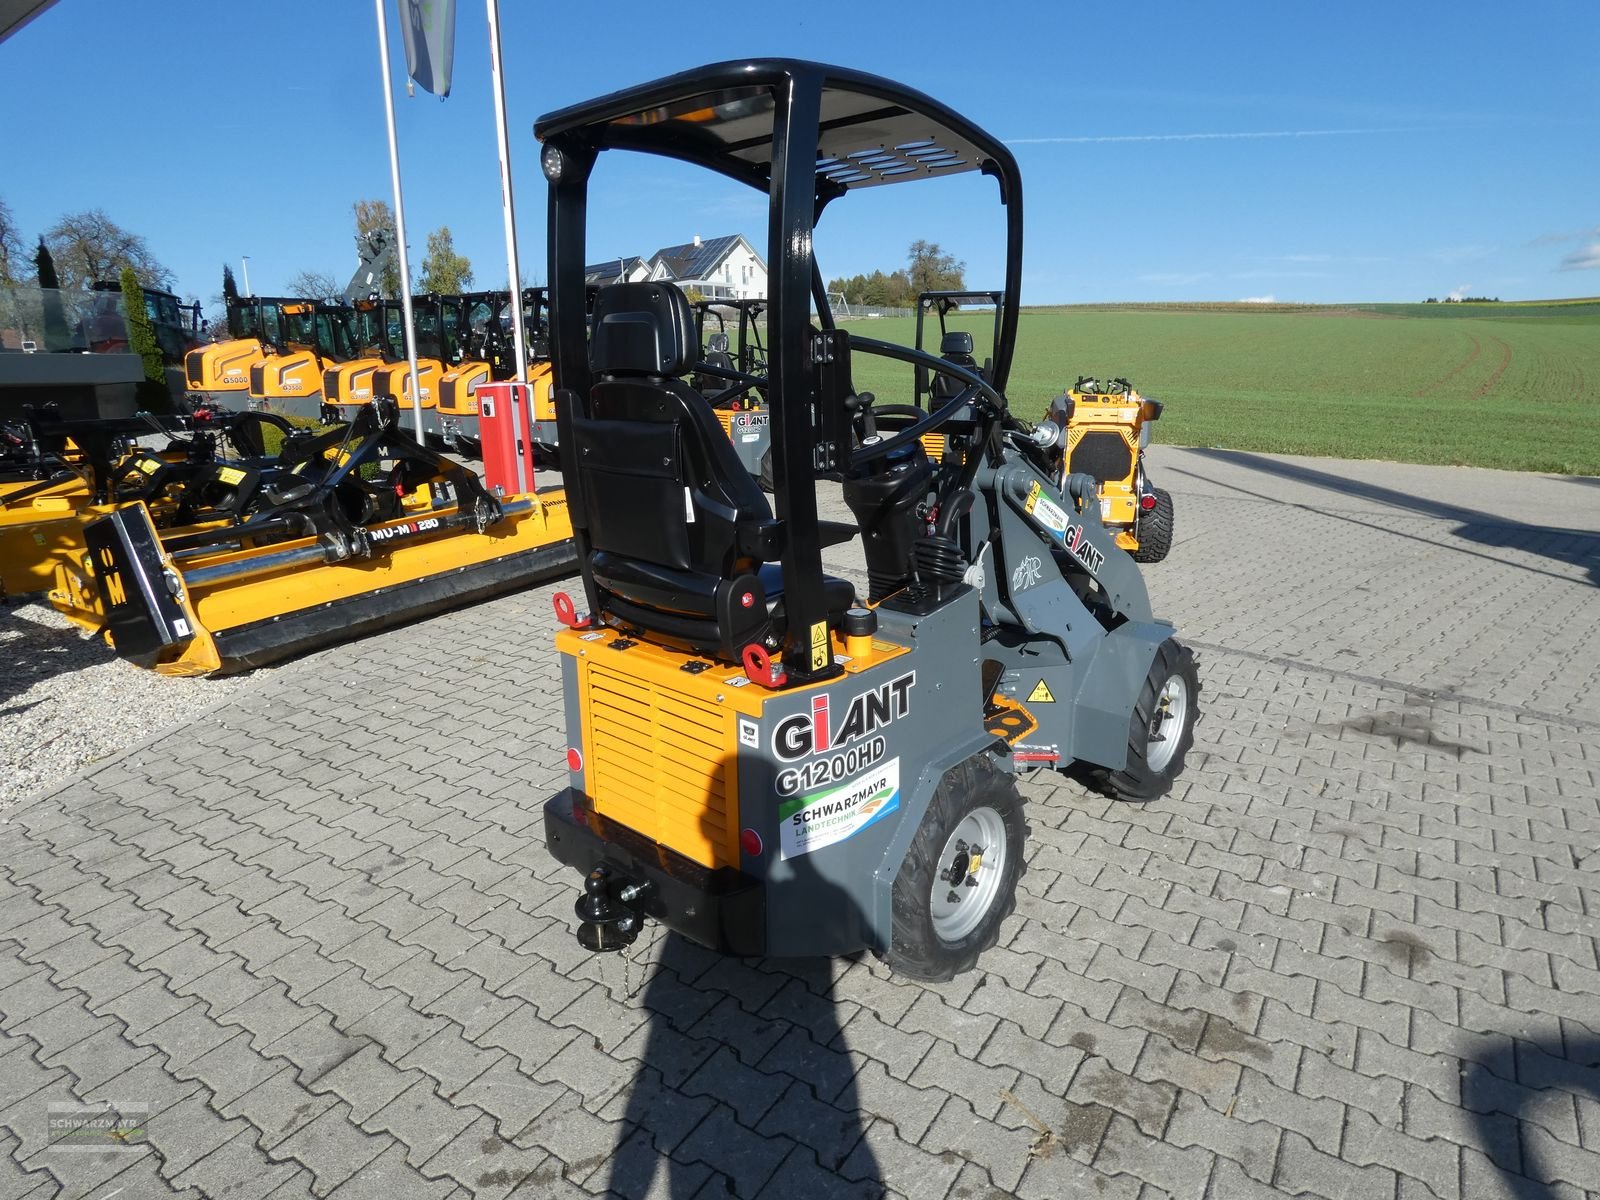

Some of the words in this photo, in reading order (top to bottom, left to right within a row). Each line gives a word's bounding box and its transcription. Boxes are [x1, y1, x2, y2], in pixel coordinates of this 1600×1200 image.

[223, 376, 248, 384] G5000
[417, 518, 439, 531] 280
[775, 735, 886, 797] G1200HD
[792, 777, 887, 826] SCHWARZMAYR
[795, 809, 857, 836] LANDTECHNIK
